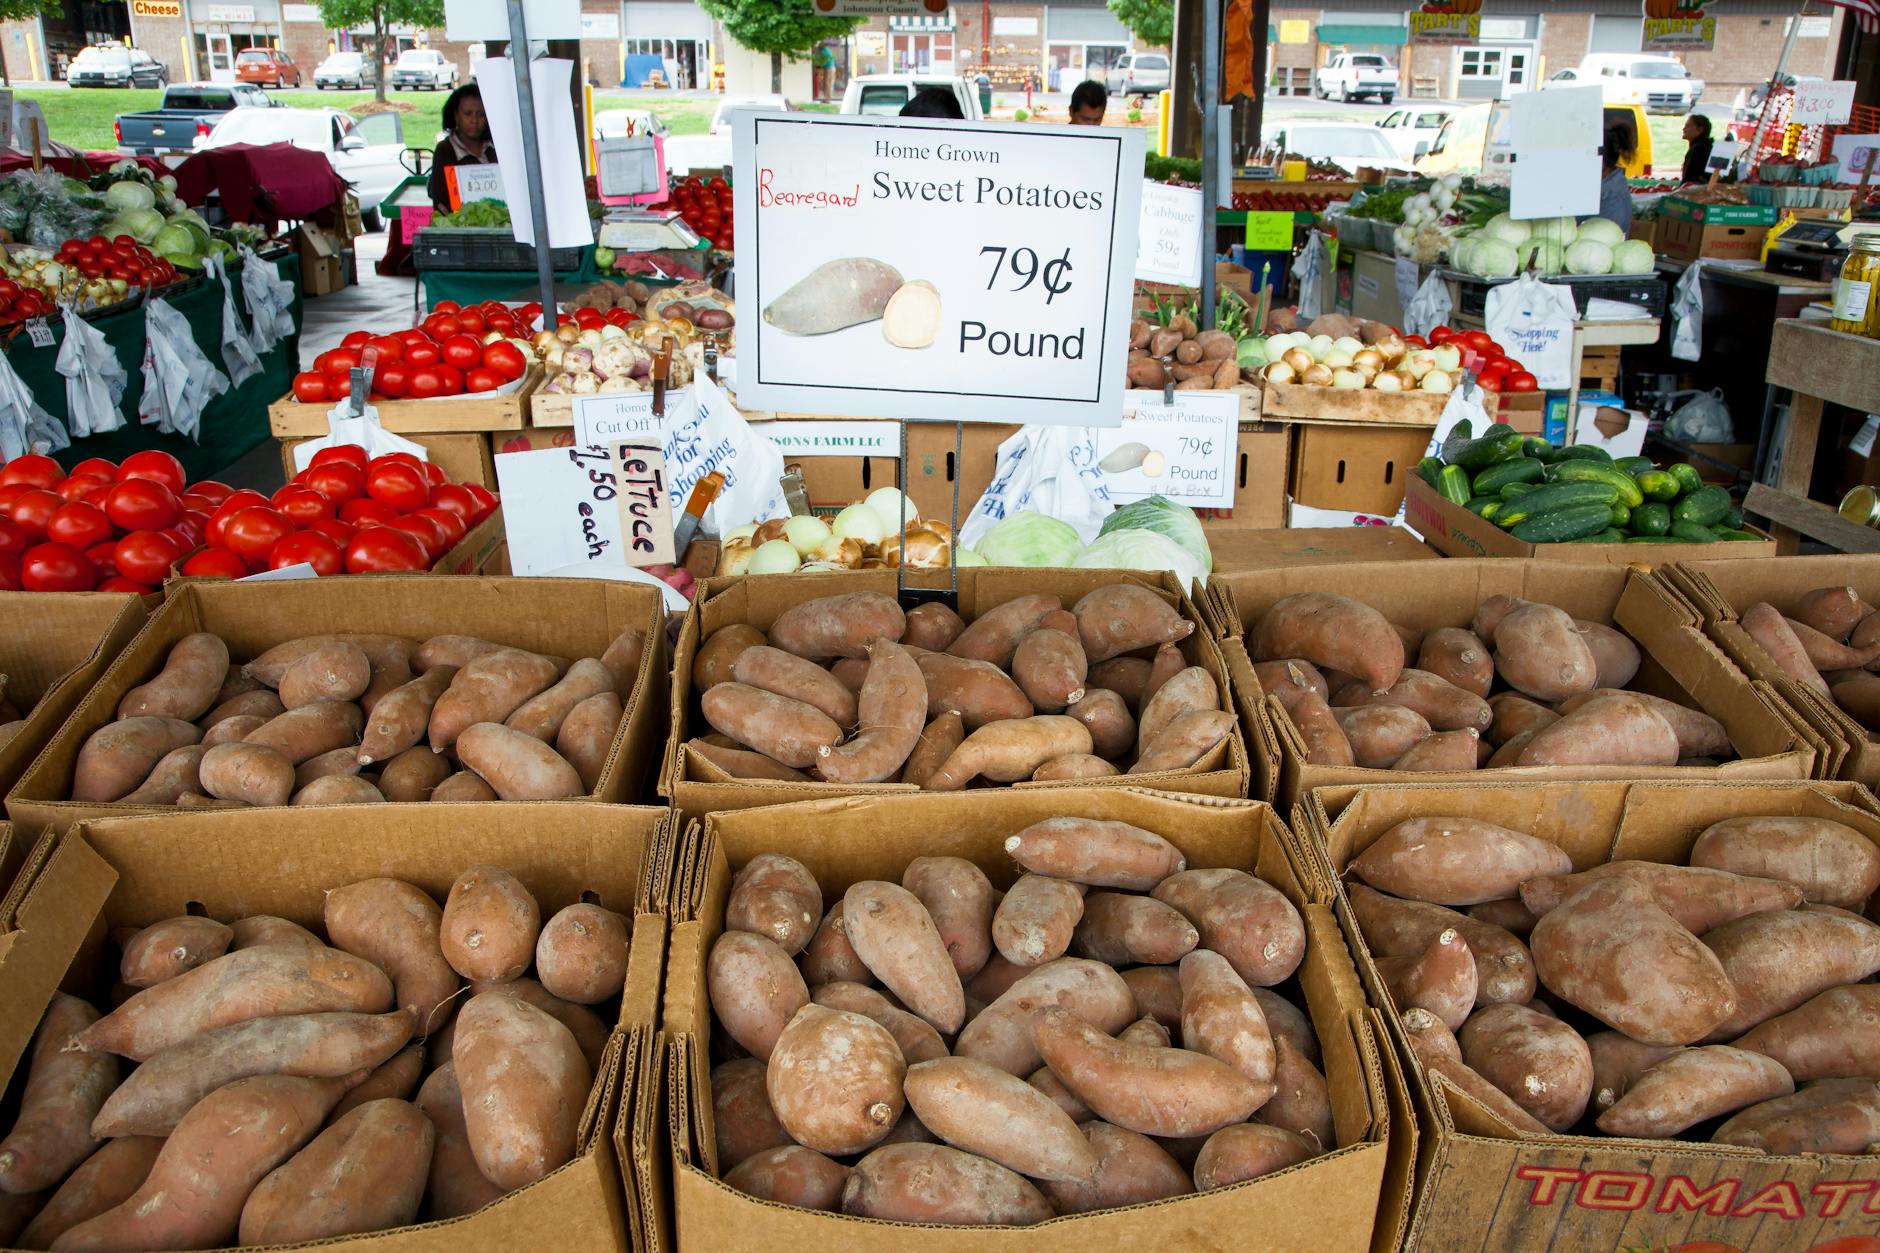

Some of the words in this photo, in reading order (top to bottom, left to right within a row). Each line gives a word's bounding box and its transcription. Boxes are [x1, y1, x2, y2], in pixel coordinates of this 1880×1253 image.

[135, 2, 179, 15] Cheese
[843, 5, 883, 13] Johnston
[886, 6, 919, 14] County
[875, 140, 930, 160] Home
[936, 143, 1000, 164] Grown
[873, 171, 965, 203] Sweet
[976, 177, 1103, 211] Potatoes
[1145, 205, 1195, 224] Cabbage
[978, 246, 1073, 305] 79¢
[960, 321, 1084, 360] Pound
[616, 403, 647, 414] Home
[1140, 410, 1173, 422] Sweet
[1177, 412, 1224, 424] Potatoes
[596, 419, 621, 434] Cut
[627, 417, 650, 431] Off
[1239, 424, 1264, 432] PREM
[769, 437, 810, 446] SONS
[814, 437, 854, 446] FARM
[859, 437, 885, 447] LLC
[1178, 437, 1213, 458] 79¢
[675, 437, 702, 475] for
[669, 437, 737, 509] Shopping
[1170, 466, 1218, 480] Pound
[578, 501, 610, 560] each
[1516, 1165, 1880, 1221] TOMAT
